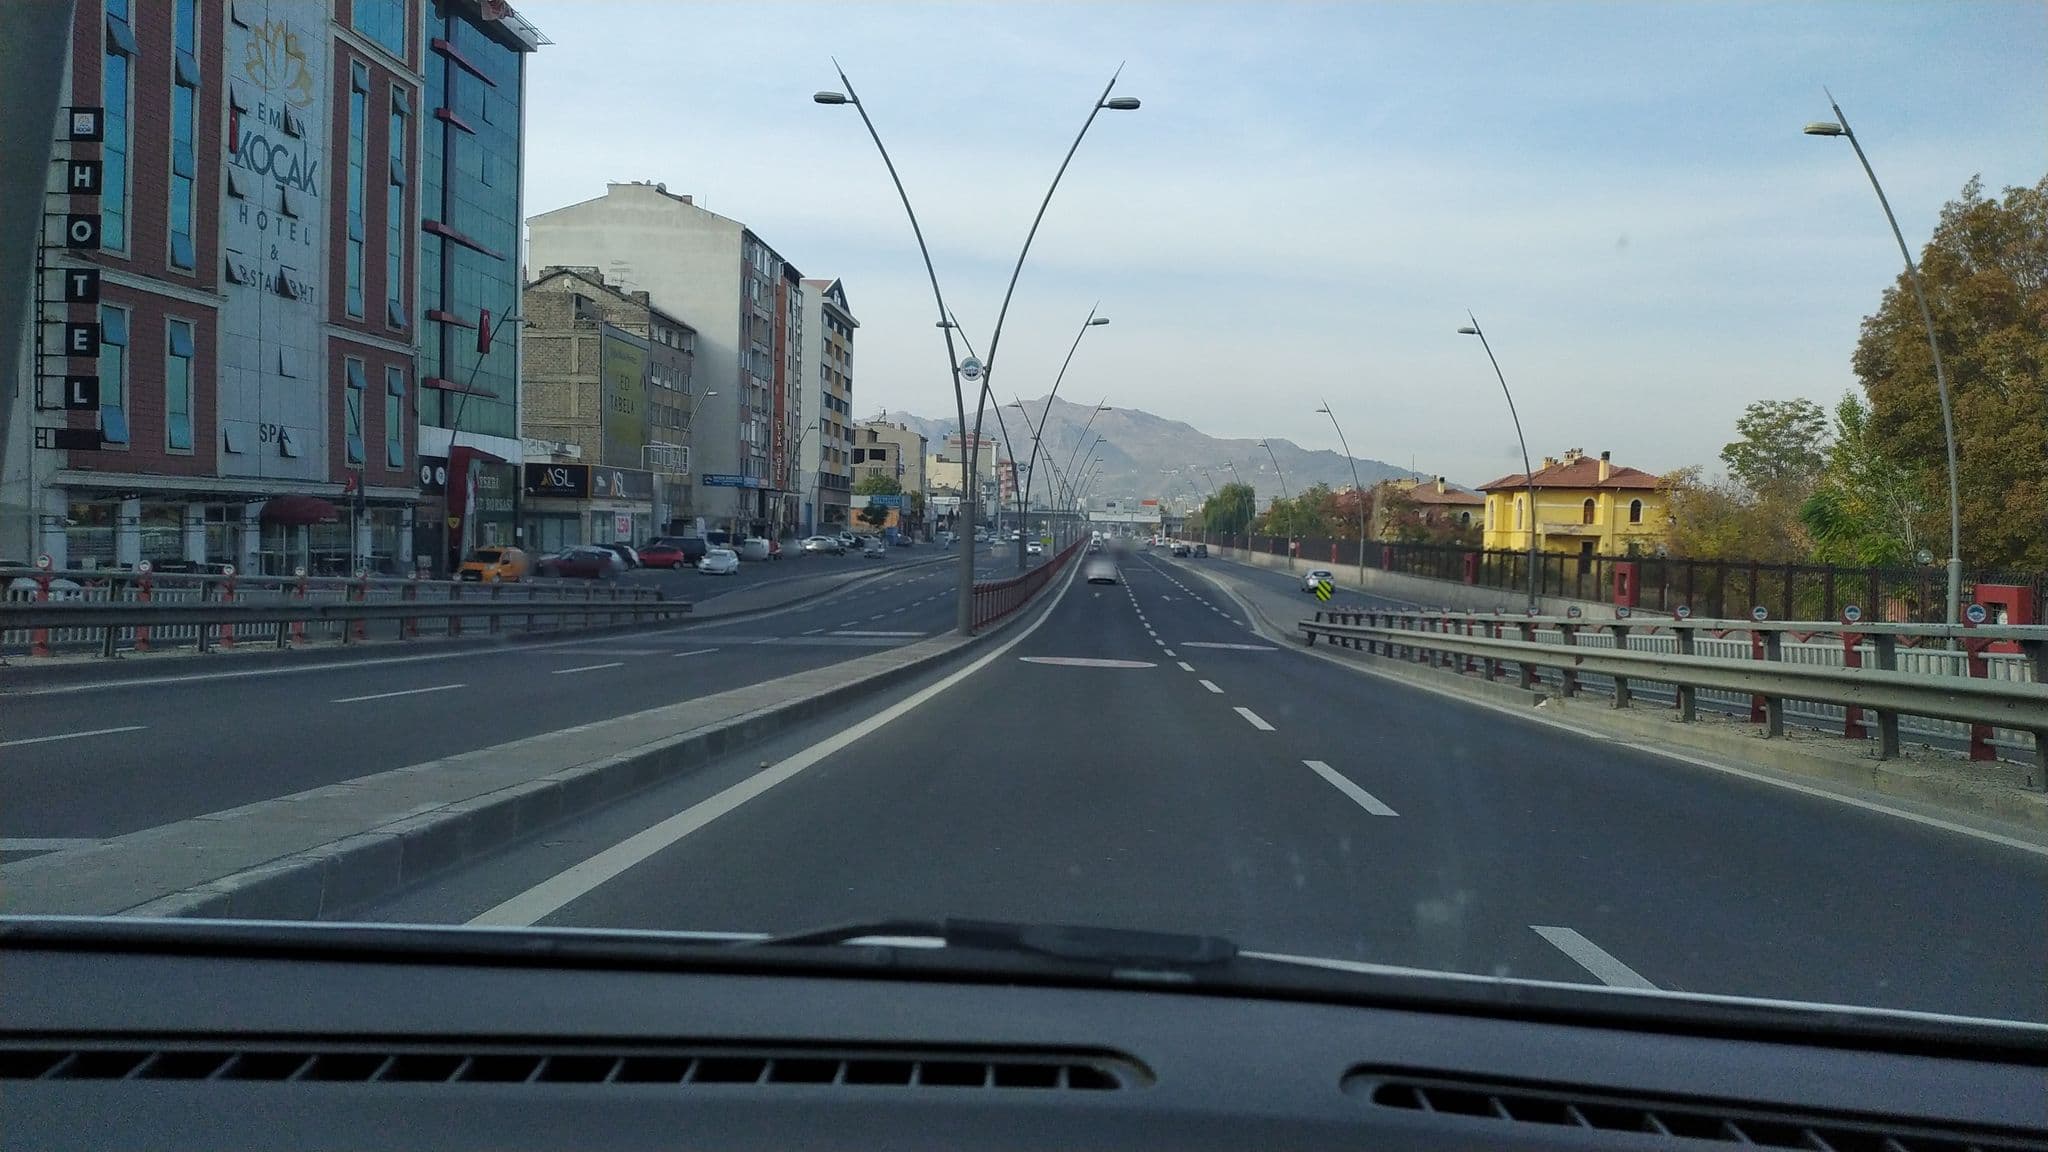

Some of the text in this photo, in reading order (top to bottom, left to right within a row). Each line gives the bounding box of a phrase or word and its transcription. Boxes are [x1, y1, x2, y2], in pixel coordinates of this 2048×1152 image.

[240, 203, 310, 246] HOTEL
[270, 244, 279, 260] &
[71, 165, 92, 404] HOTEL
[260, 424, 291, 443] SPA
